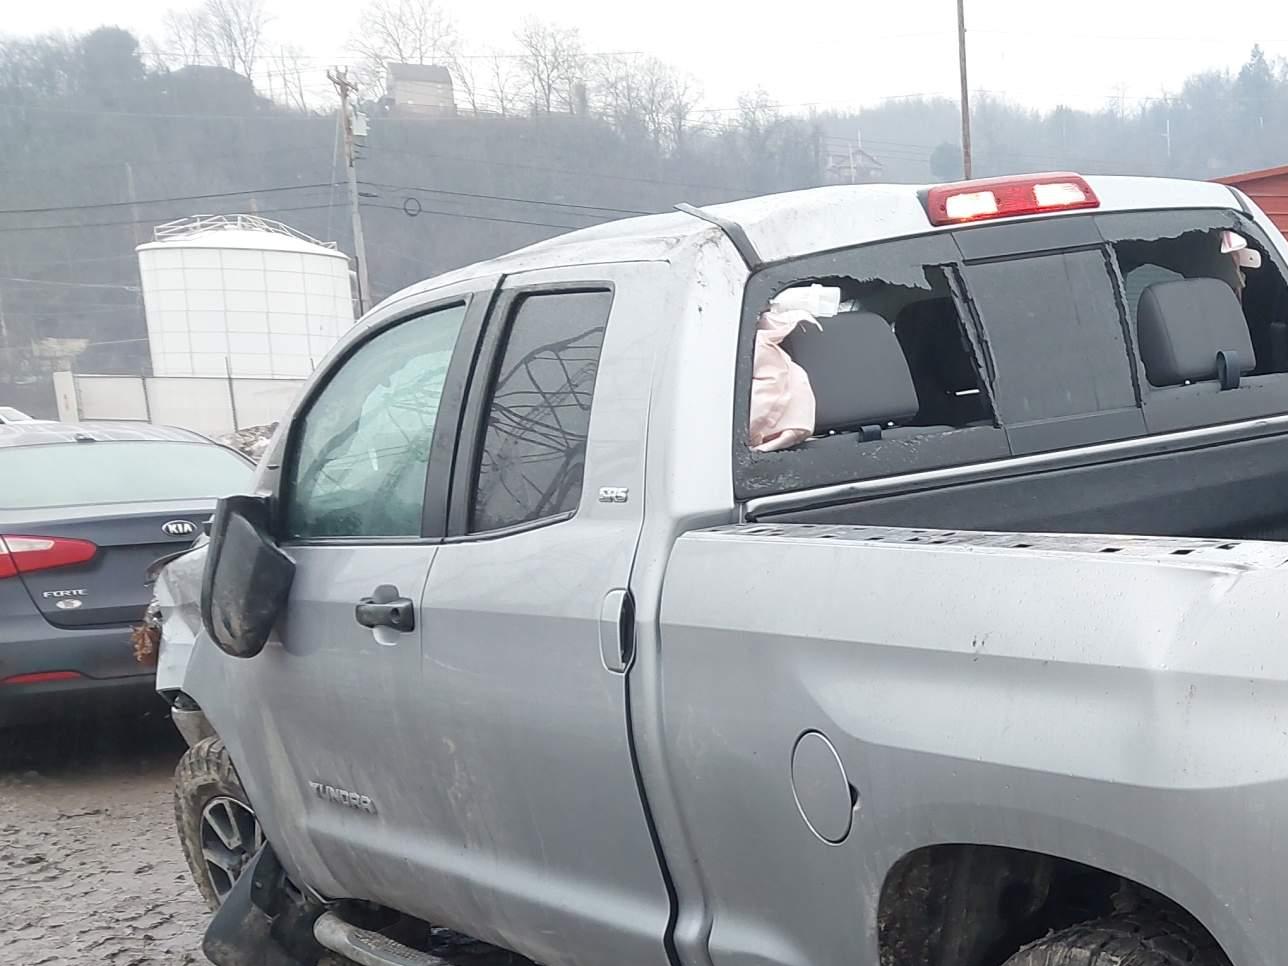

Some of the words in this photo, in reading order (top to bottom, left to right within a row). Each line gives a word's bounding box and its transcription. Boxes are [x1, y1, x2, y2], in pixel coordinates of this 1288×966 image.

[167, 521, 193, 534] KIA
[41, 589, 88, 599] FORTE
[308, 780, 377, 814] TUNDRA
